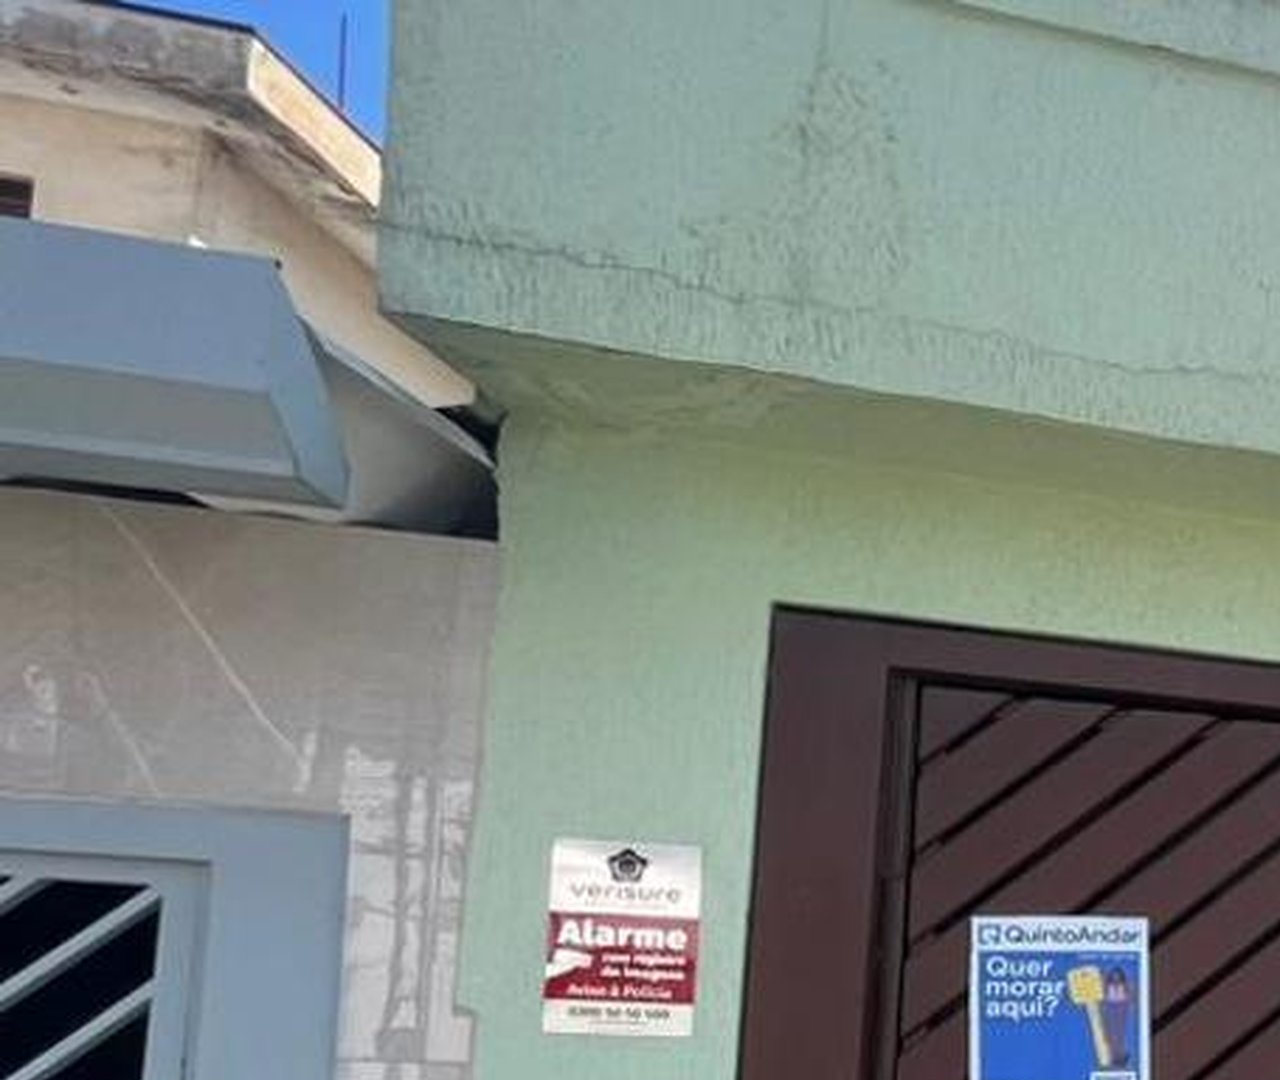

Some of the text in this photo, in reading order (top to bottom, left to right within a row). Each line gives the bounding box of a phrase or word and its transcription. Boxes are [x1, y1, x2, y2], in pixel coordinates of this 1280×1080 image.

[570, 882, 681, 904] verisure
[557, 919, 688, 950] Alarme
[1005, 924, 1138, 944] QuintoAndar
[986, 956, 1054, 978] Quer
[985, 980, 1065, 996] morar
[985, 996, 1060, 1023] aqui?
